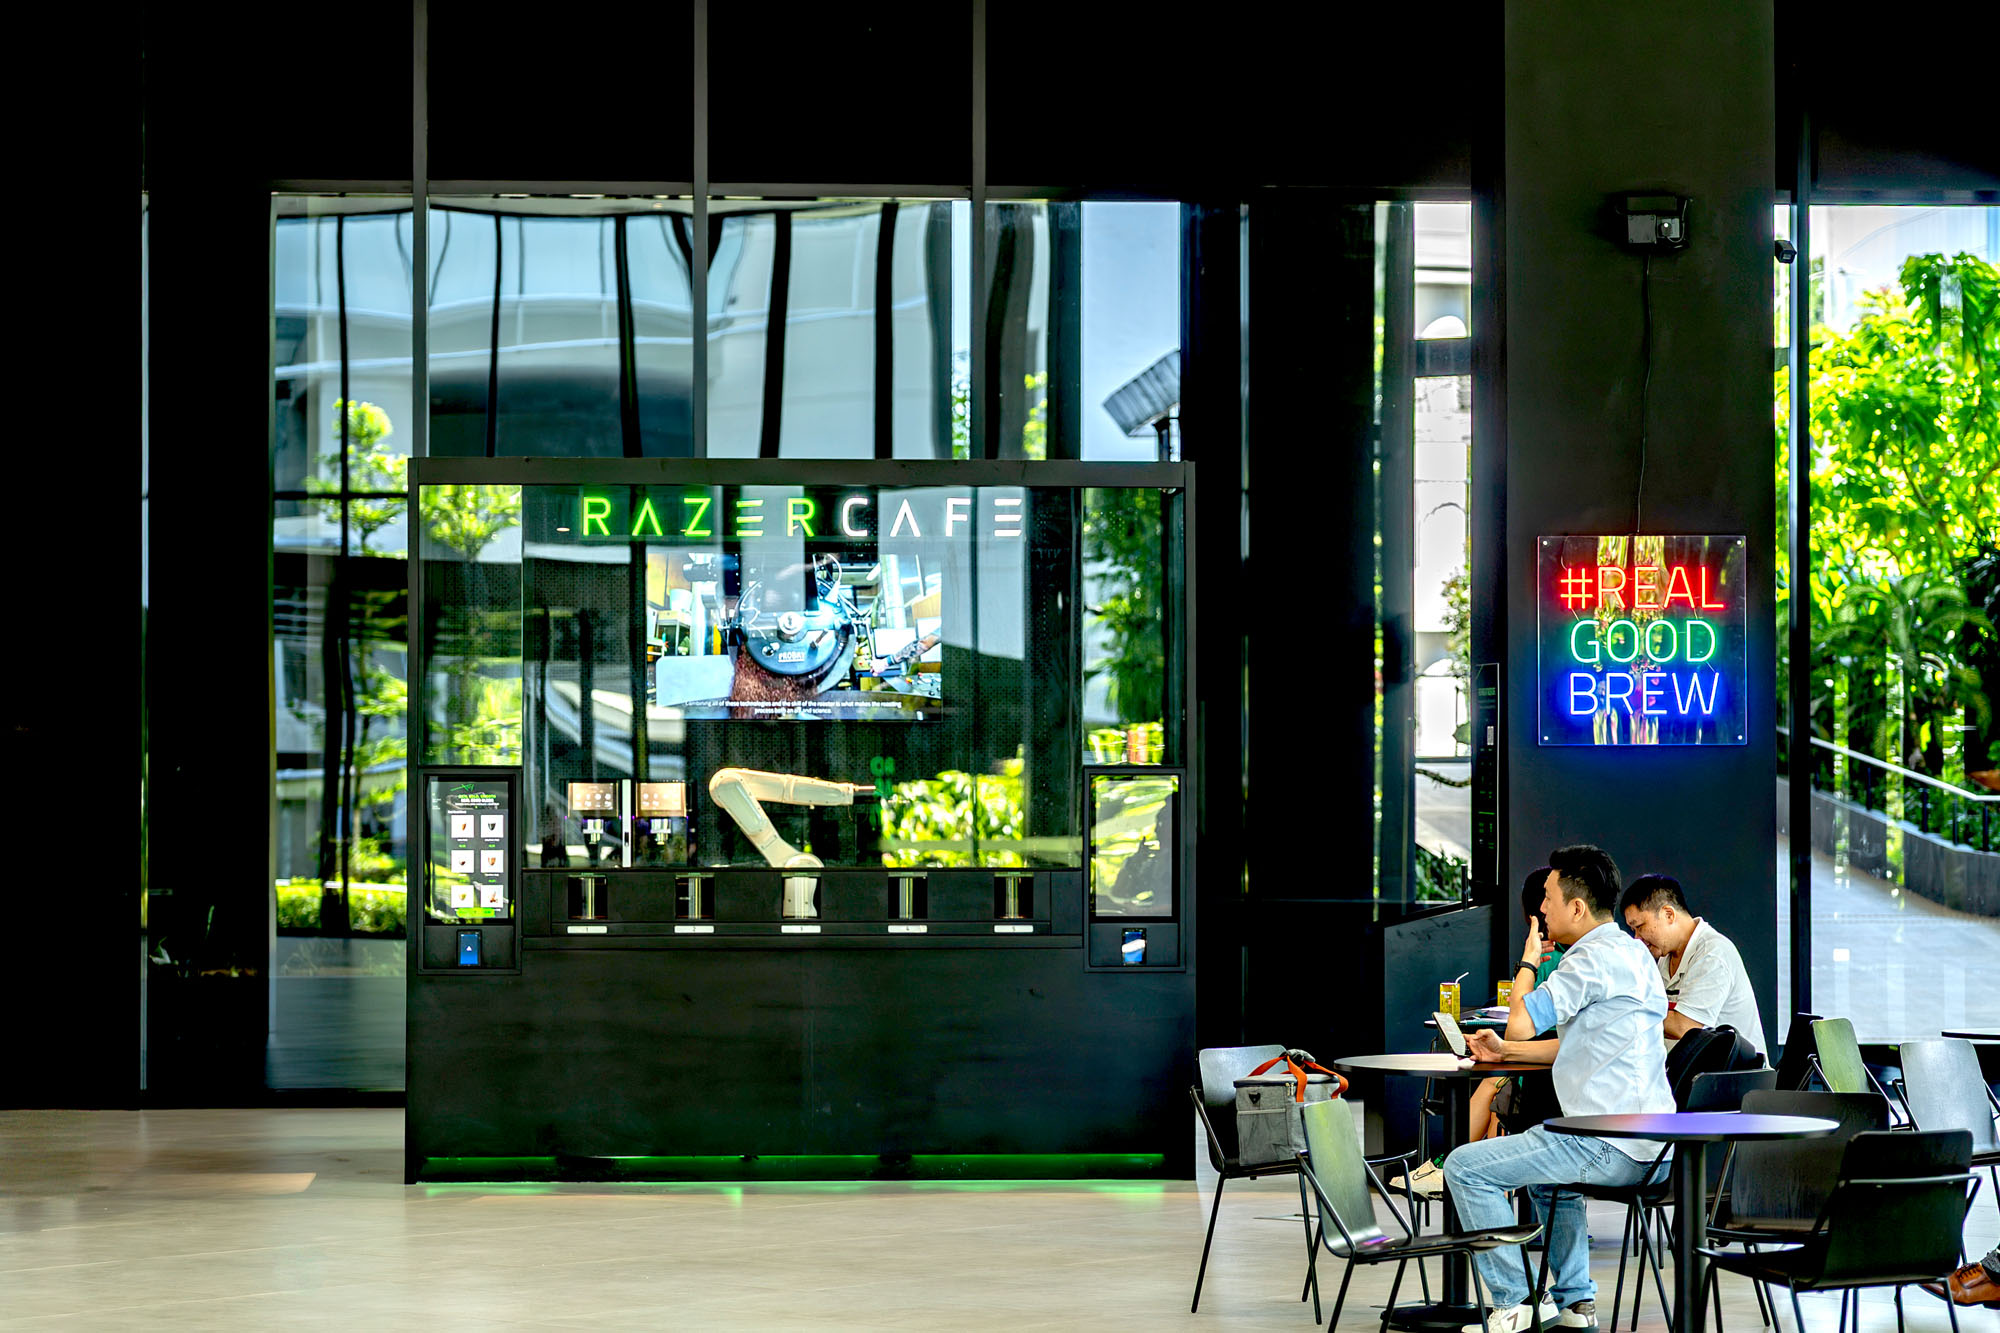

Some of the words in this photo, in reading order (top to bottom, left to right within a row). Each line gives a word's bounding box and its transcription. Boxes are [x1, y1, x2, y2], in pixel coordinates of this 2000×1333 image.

[581, 497, 817, 537] RAZER
[841, 497, 1024, 537] CAFE
[1560, 566, 1724, 609] #REAL
[1570, 619, 1717, 663] GOOD
[1569, 672, 1720, 716] BREW
